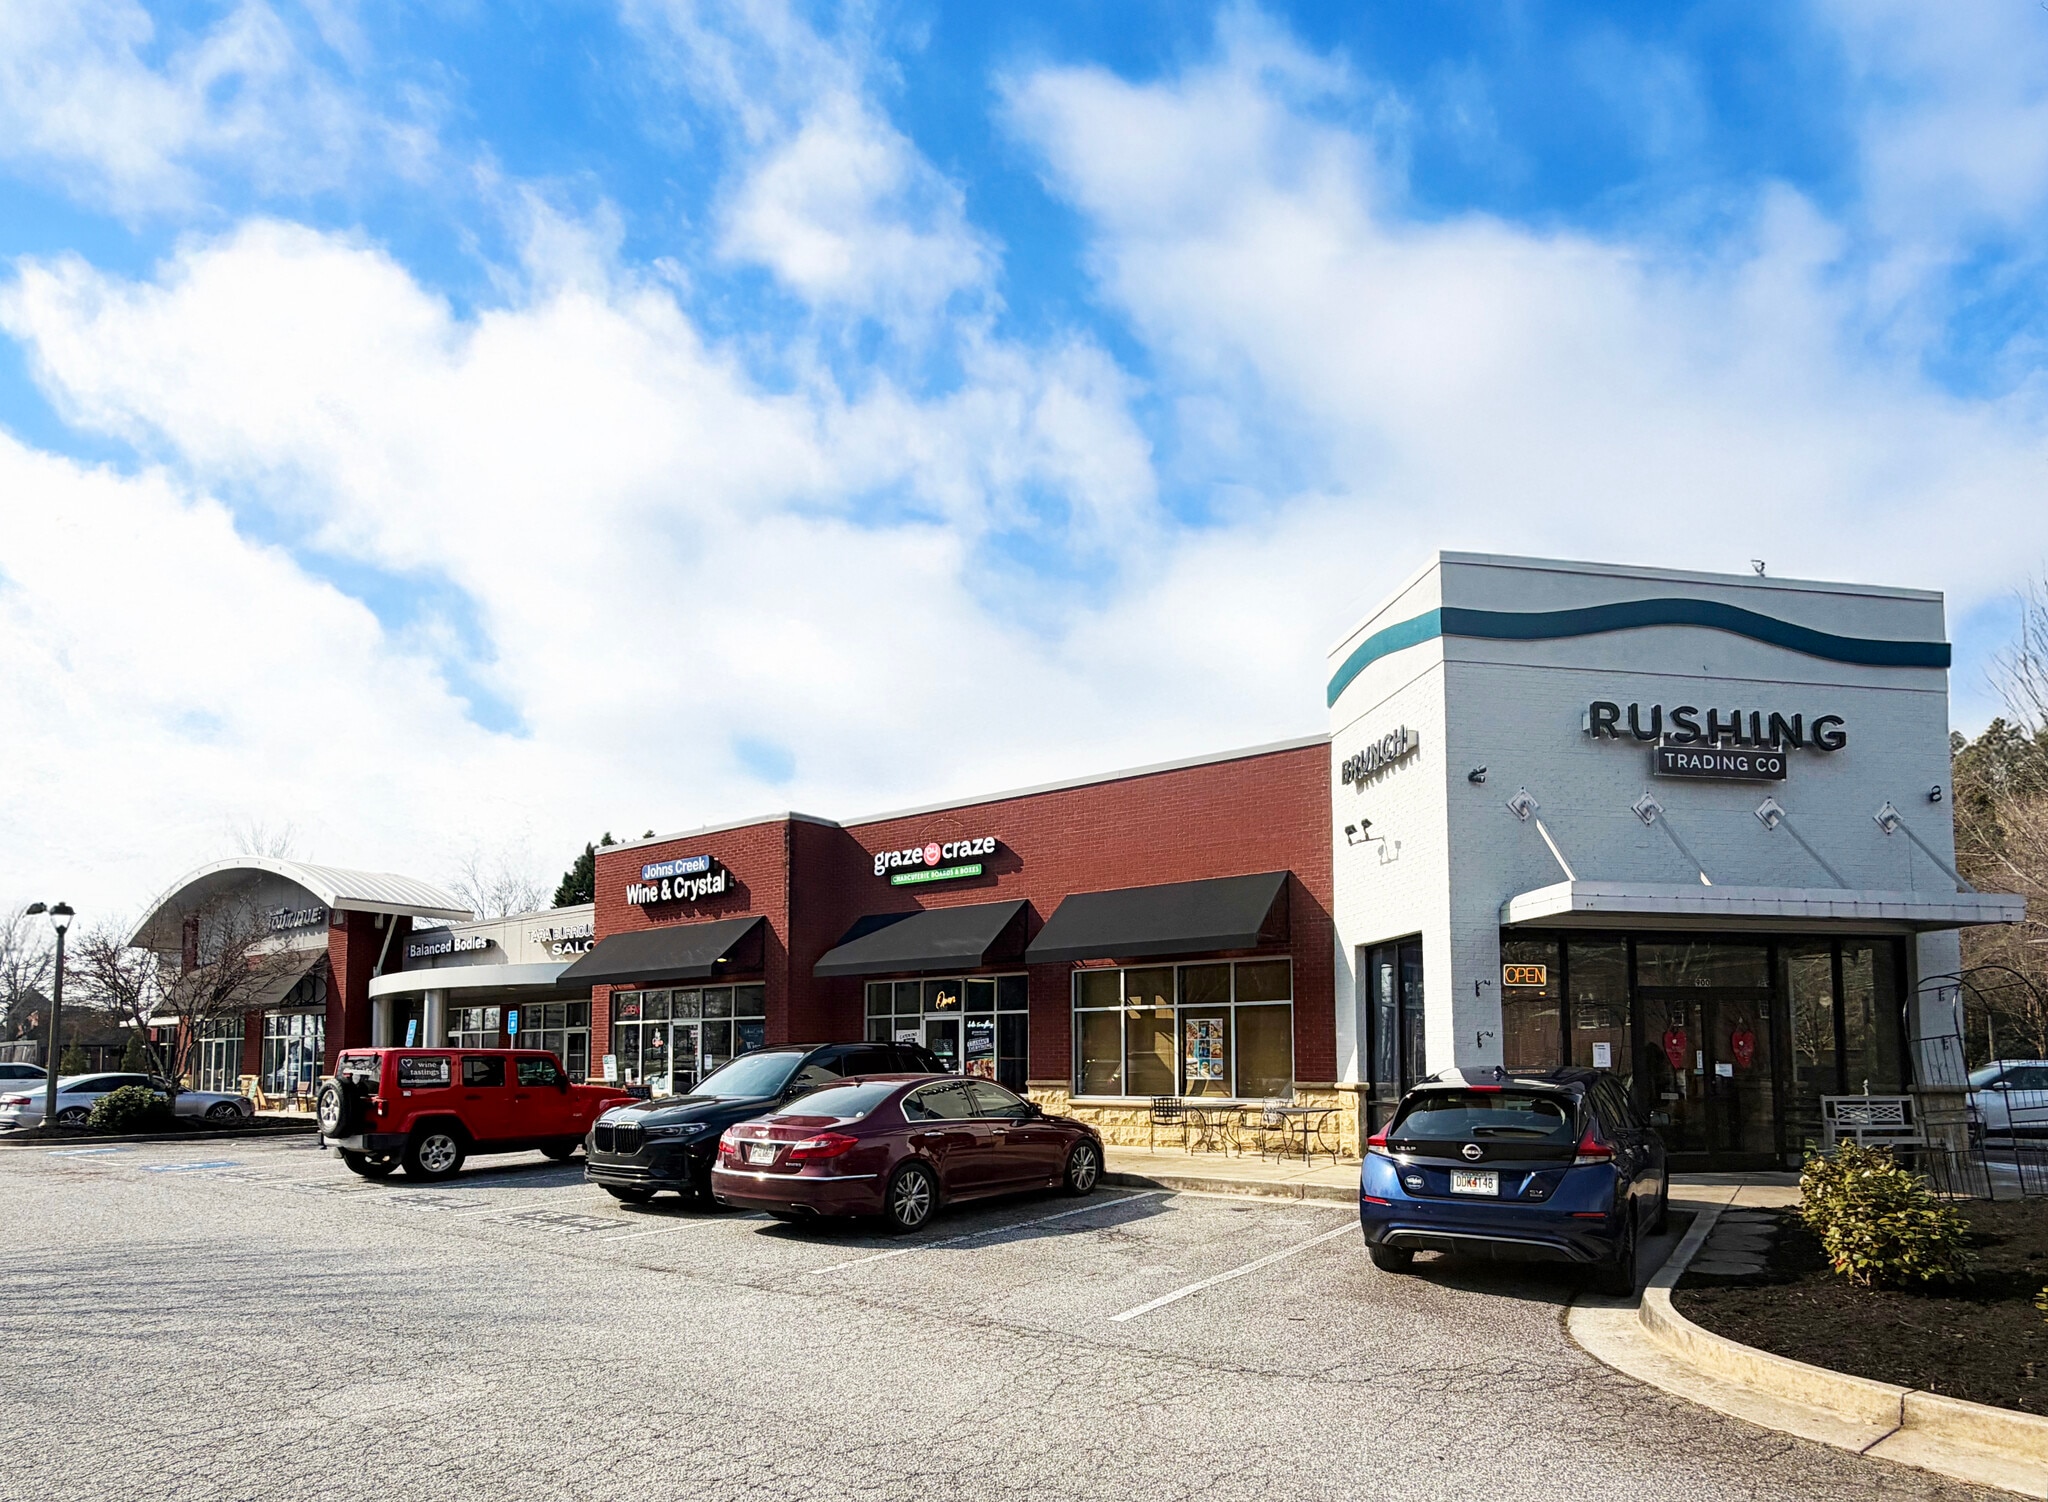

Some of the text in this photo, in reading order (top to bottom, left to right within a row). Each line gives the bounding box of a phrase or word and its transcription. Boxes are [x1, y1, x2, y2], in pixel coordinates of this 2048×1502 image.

[1589, 700, 1847, 752] RUSHING
[1341, 724, 1408, 786] BRUNCH
[1664, 752, 1780, 773] TRADING CO
[874, 836, 996, 876] graze craze
[644, 857, 705, 878] Johns Creek
[626, 869, 725, 905] Wine & Crystal
[410, 936, 487, 957] Balanced Bodies
[1505, 966, 1545, 983] OPEN
[410, 1069, 440, 1077] tastings
